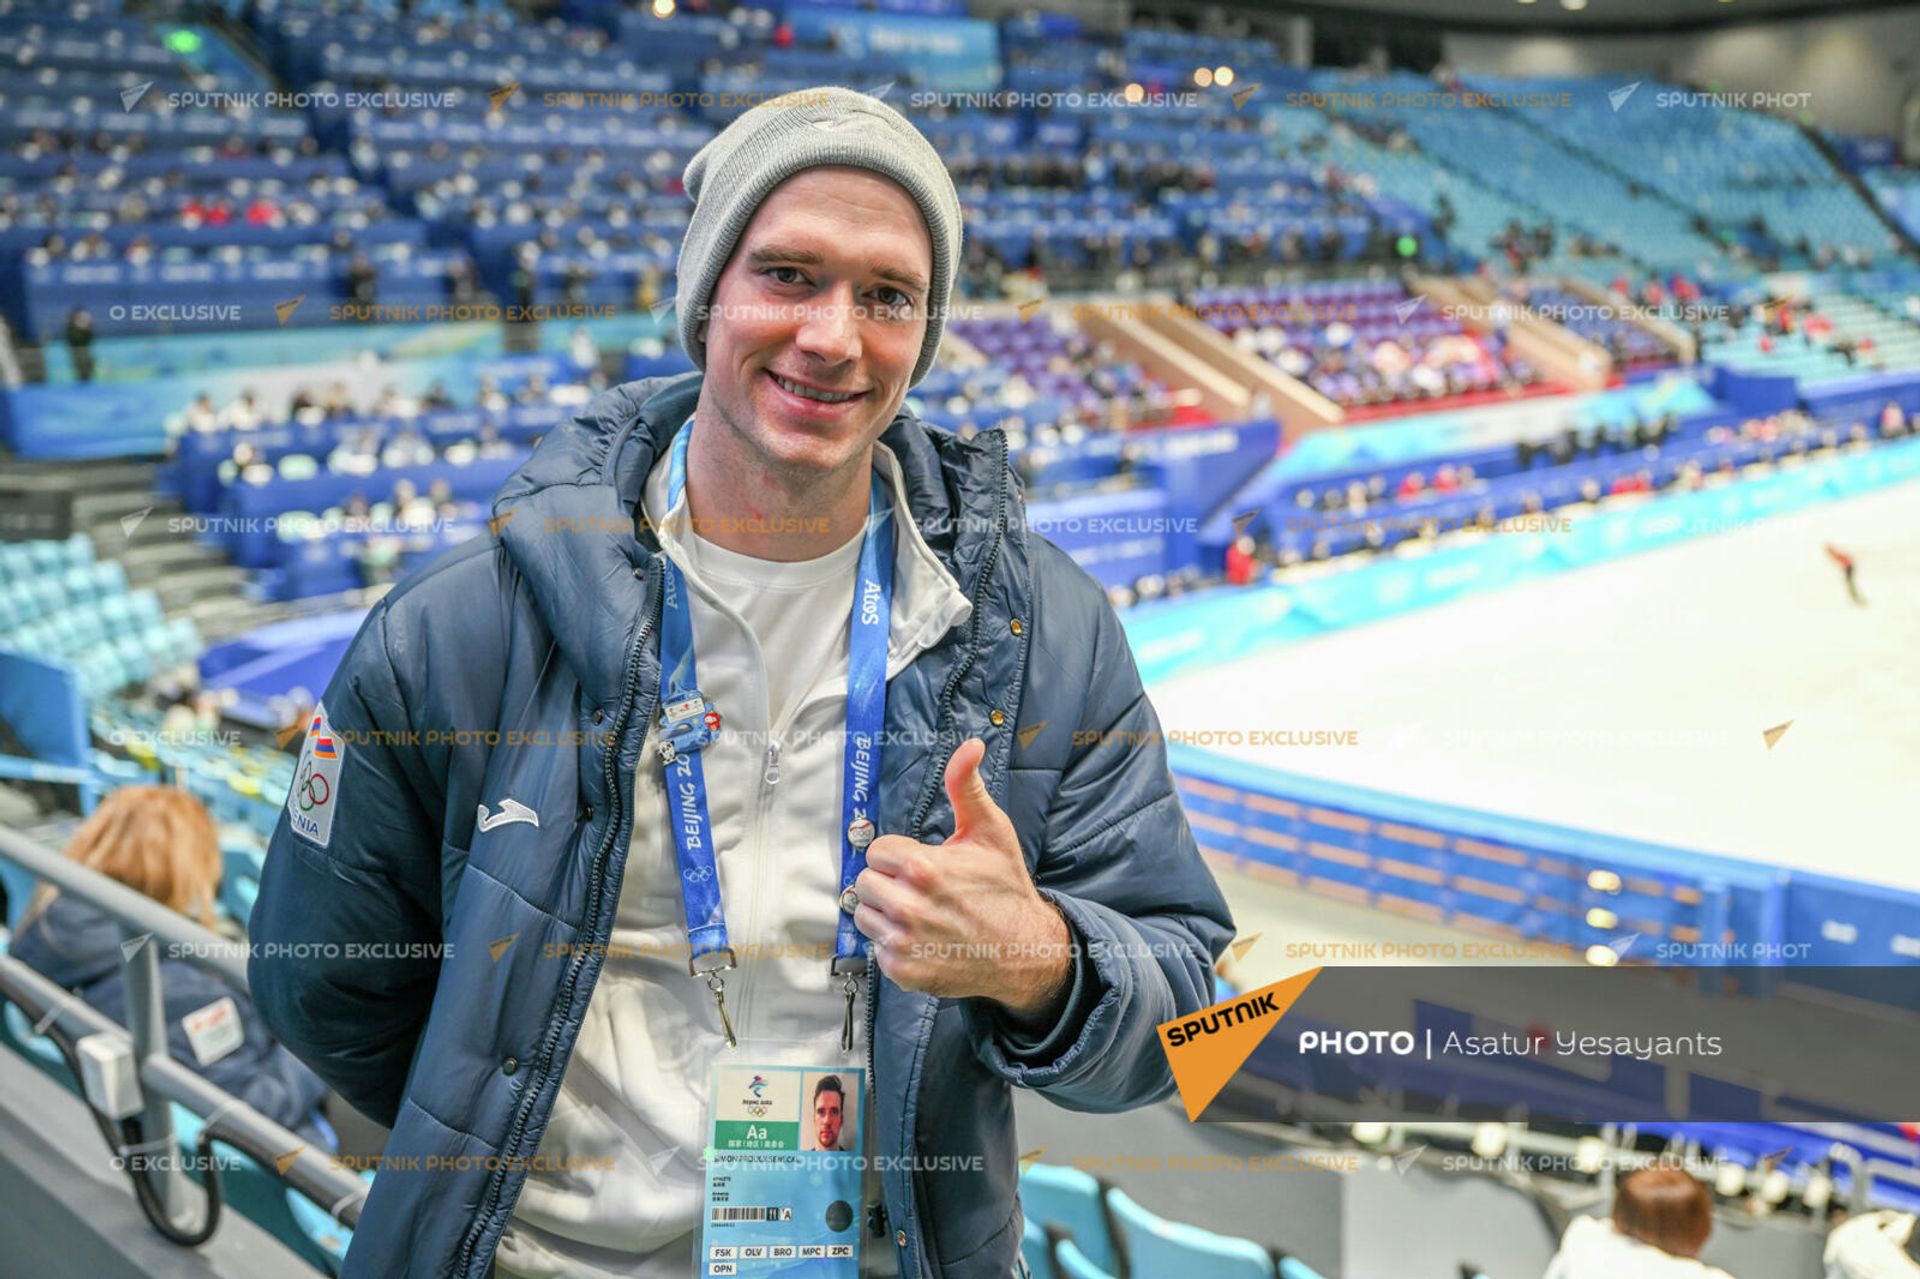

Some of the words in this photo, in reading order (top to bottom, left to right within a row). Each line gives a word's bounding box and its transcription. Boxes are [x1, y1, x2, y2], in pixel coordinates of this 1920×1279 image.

[851, 736, 872, 803] BEIJING
[676, 781, 703, 851] BEIJING
[746, 1124, 768, 1140] Aa
[715, 1249, 732, 1257] FSK
[745, 1248, 763, 1257] OLV
[773, 1247, 792, 1256] BRO
[801, 1247, 821, 1256] MPC
[831, 1246, 849, 1255] ZPC
[713, 1264, 733, 1273] OPN
